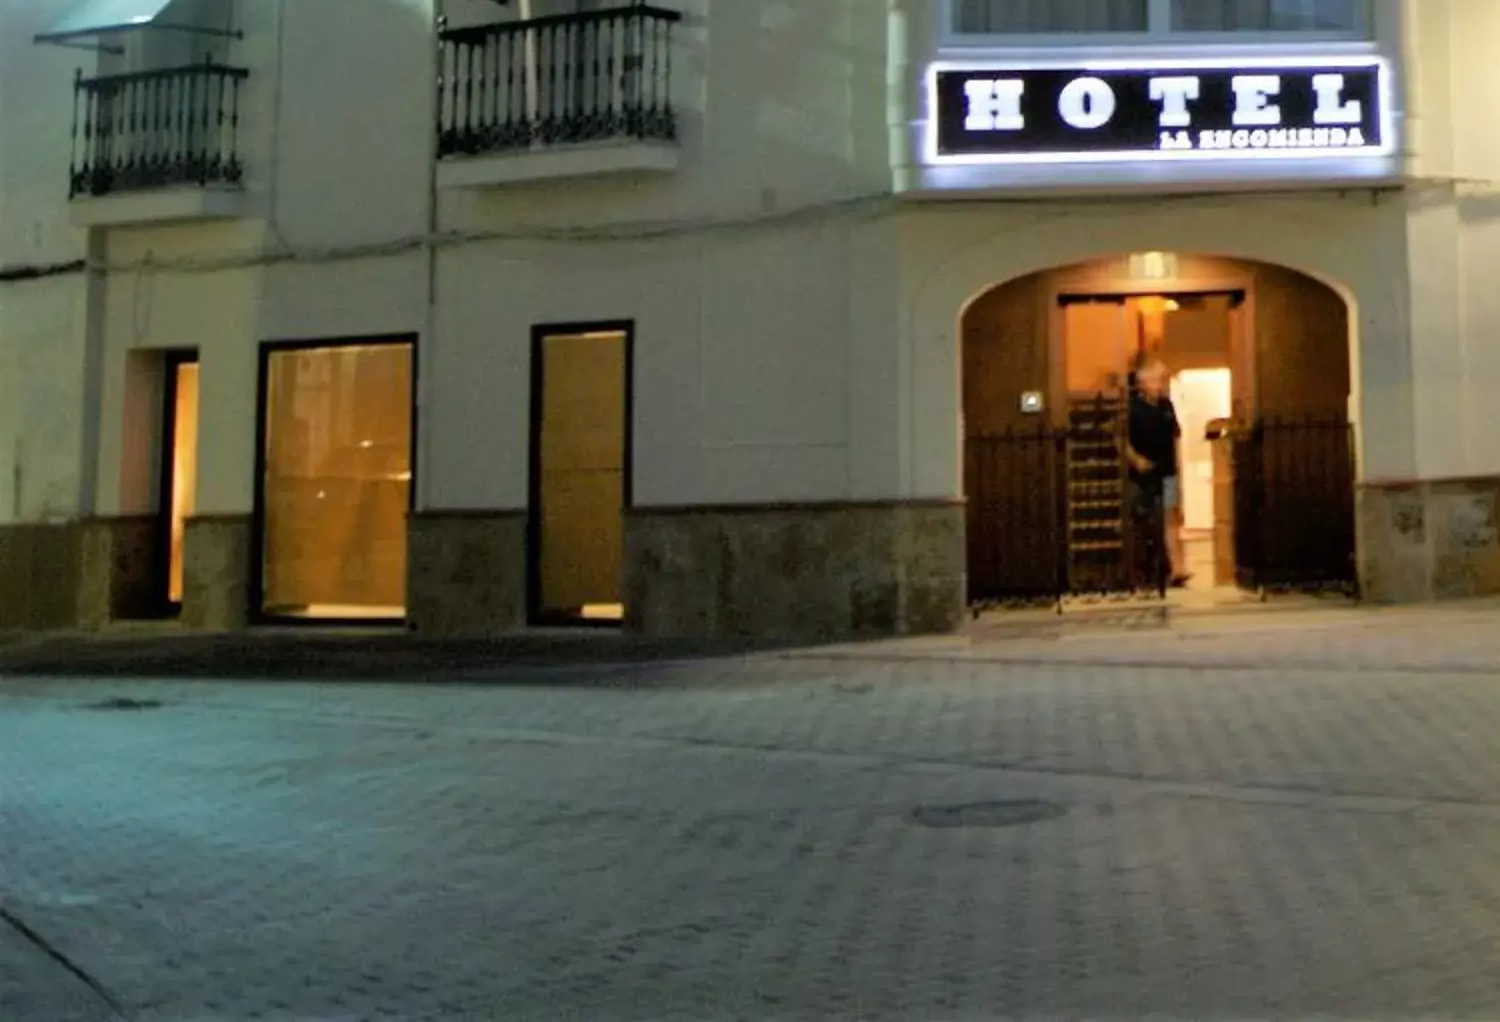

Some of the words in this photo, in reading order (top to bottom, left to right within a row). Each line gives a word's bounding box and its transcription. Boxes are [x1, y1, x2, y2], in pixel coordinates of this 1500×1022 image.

[963, 74, 1363, 130] HOTEL
[1159, 130, 1193, 149] LA
[1199, 127, 1365, 148] ENCOMIENDA
